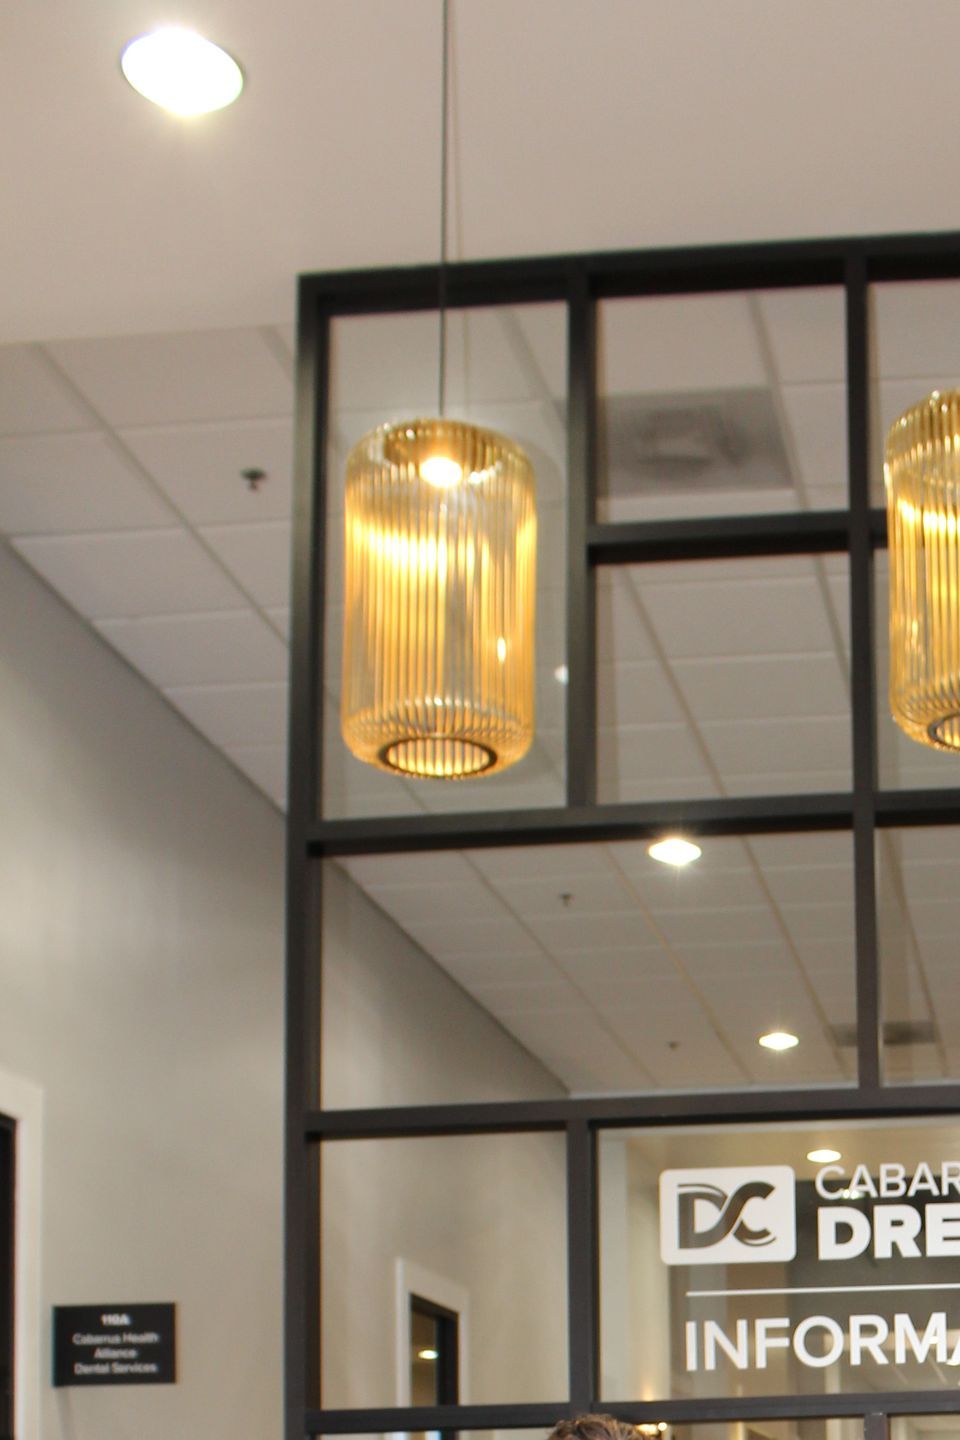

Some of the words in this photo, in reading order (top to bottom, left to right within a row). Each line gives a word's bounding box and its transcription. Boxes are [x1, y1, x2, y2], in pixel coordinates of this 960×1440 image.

[72, 1333, 121, 1345] Cabarrus
[123, 1332, 159, 1344] Health
[94, 1348, 137, 1359] Alliance
[74, 1363, 109, 1375] Dental
[112, 1361, 157, 1373] Services
